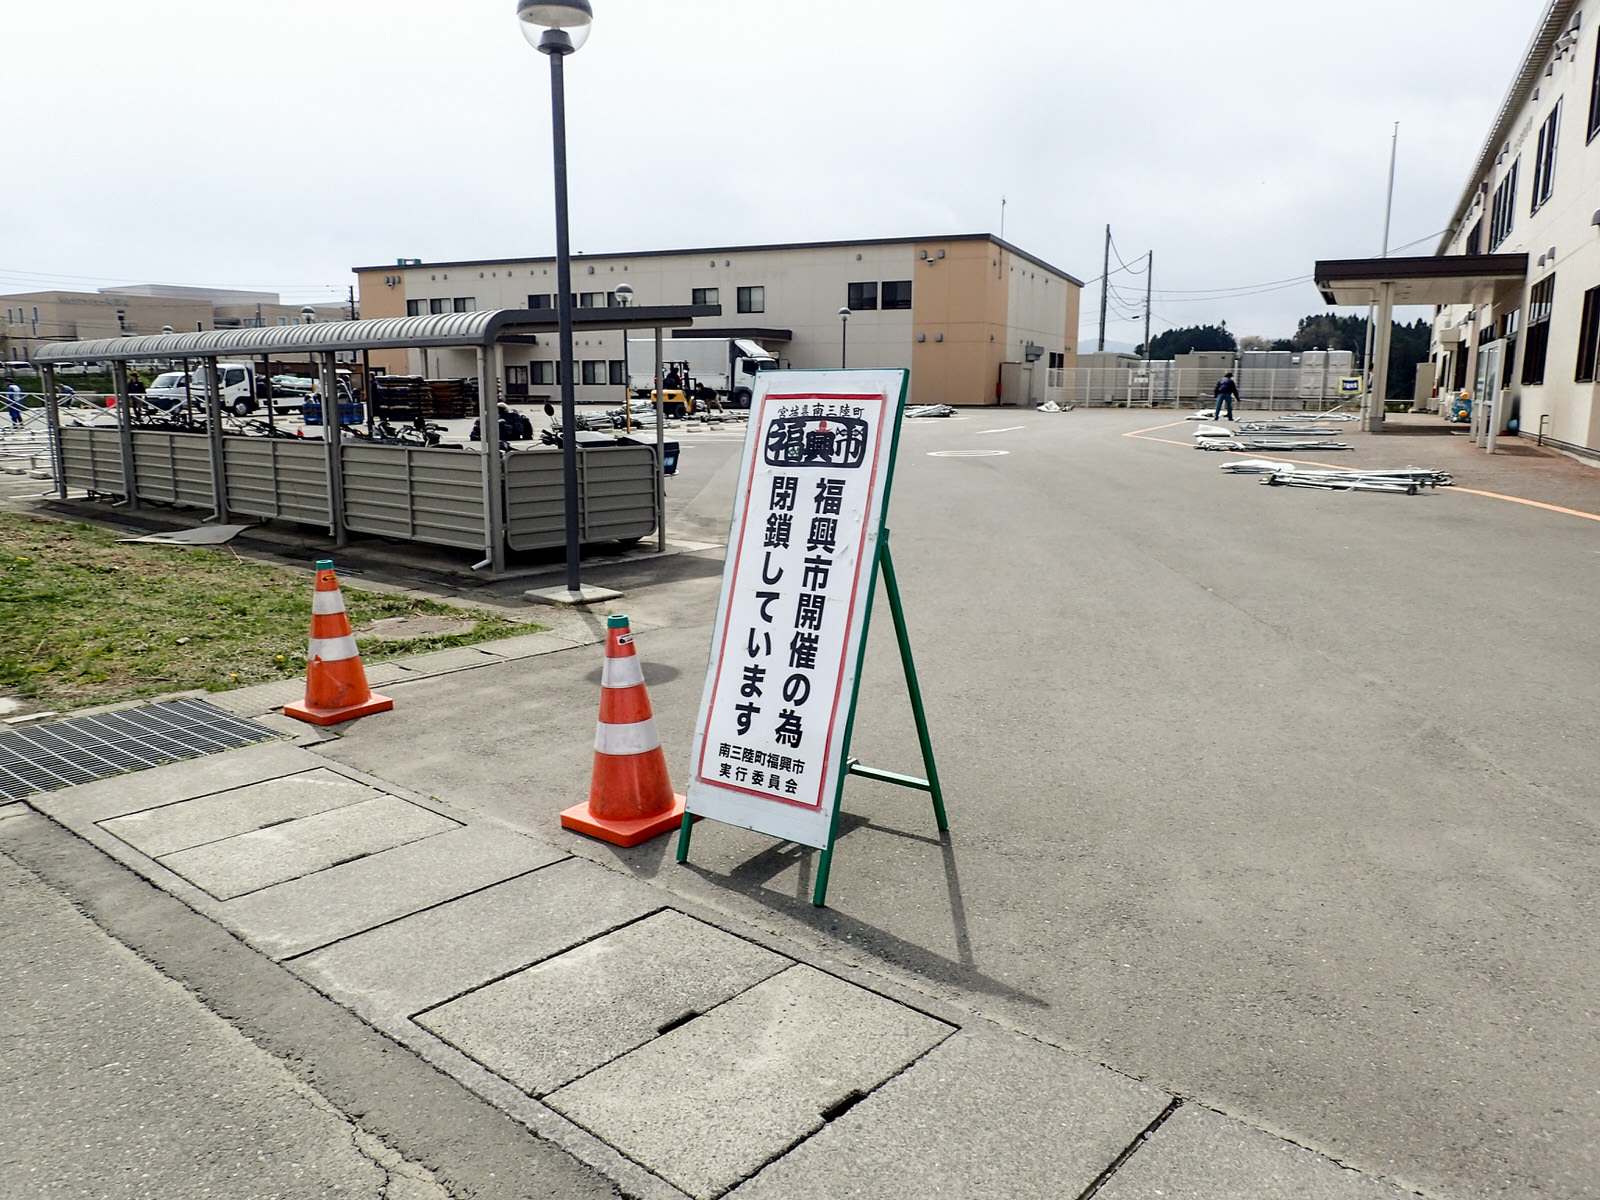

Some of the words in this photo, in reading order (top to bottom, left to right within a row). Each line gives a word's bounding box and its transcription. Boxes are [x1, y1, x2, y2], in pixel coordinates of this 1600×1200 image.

[766, 418, 867, 466] 福興市
[735, 476, 798, 736] 閉鎖しています
[775, 478, 846, 748] 福興市開催の為
[719, 743, 805, 774] 南三陸町福興市
[719, 763, 798, 794] 実行委員会
